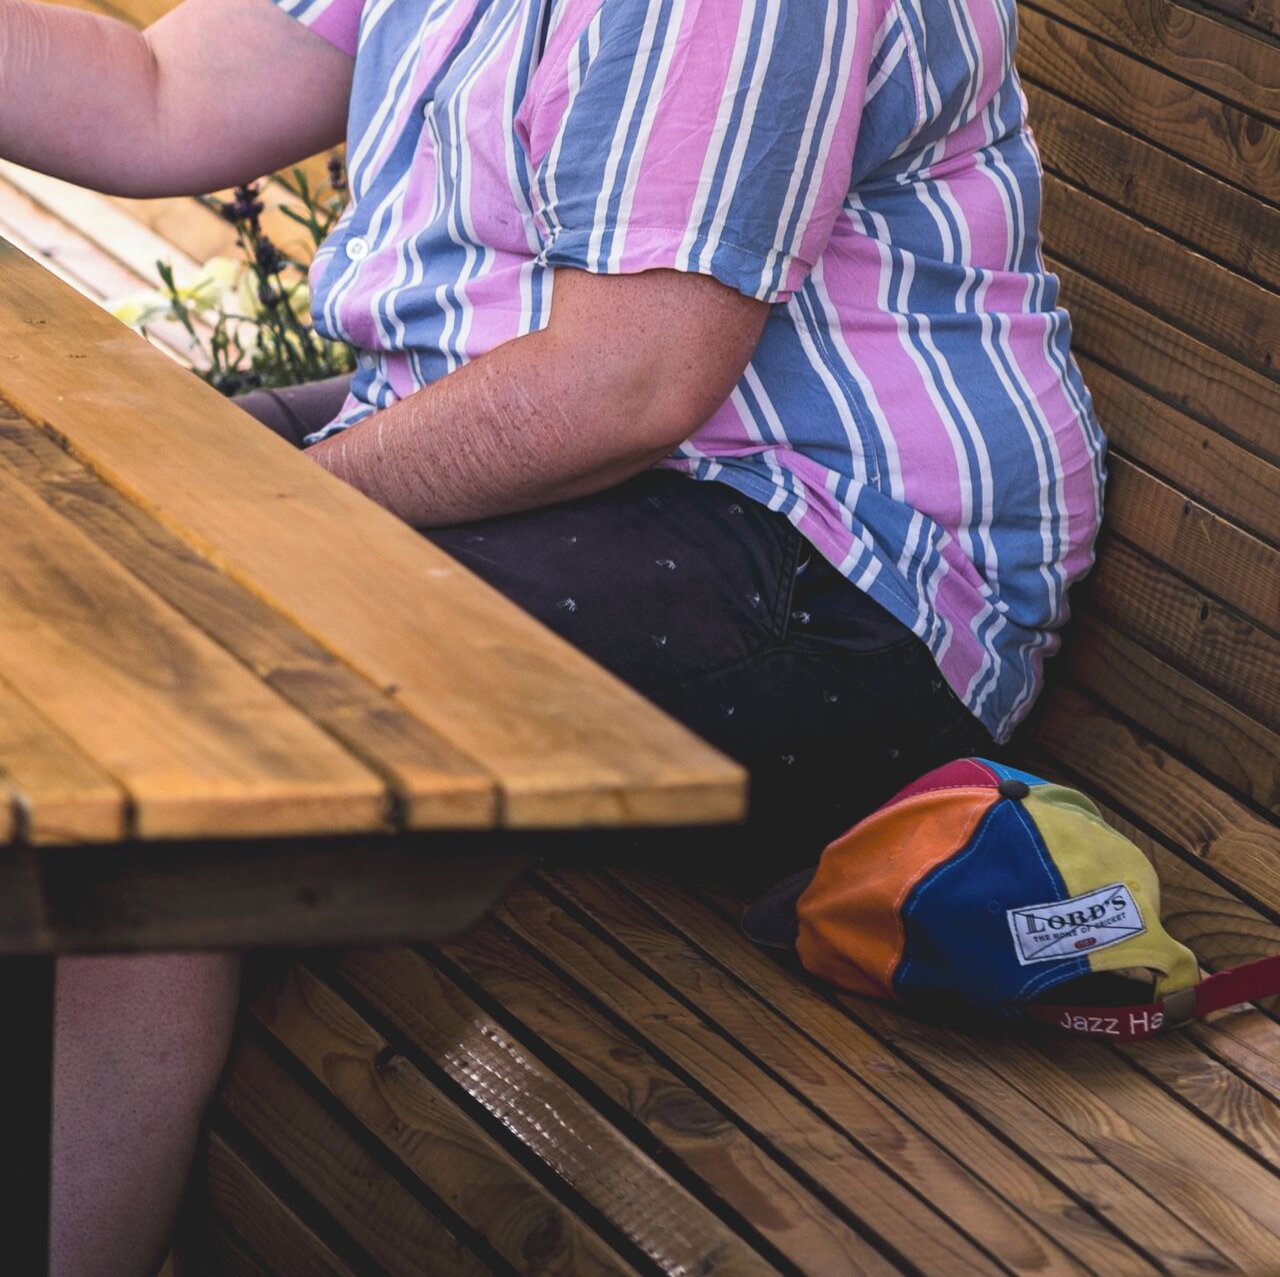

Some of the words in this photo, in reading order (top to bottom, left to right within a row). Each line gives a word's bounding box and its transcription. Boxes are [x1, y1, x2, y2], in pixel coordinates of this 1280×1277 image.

[1025, 895, 1127, 935] LORD'S
[1033, 934, 1051, 943] THE
[1060, 1012, 1120, 1035] Jazz
[1129, 1011, 1164, 1035] Ha
